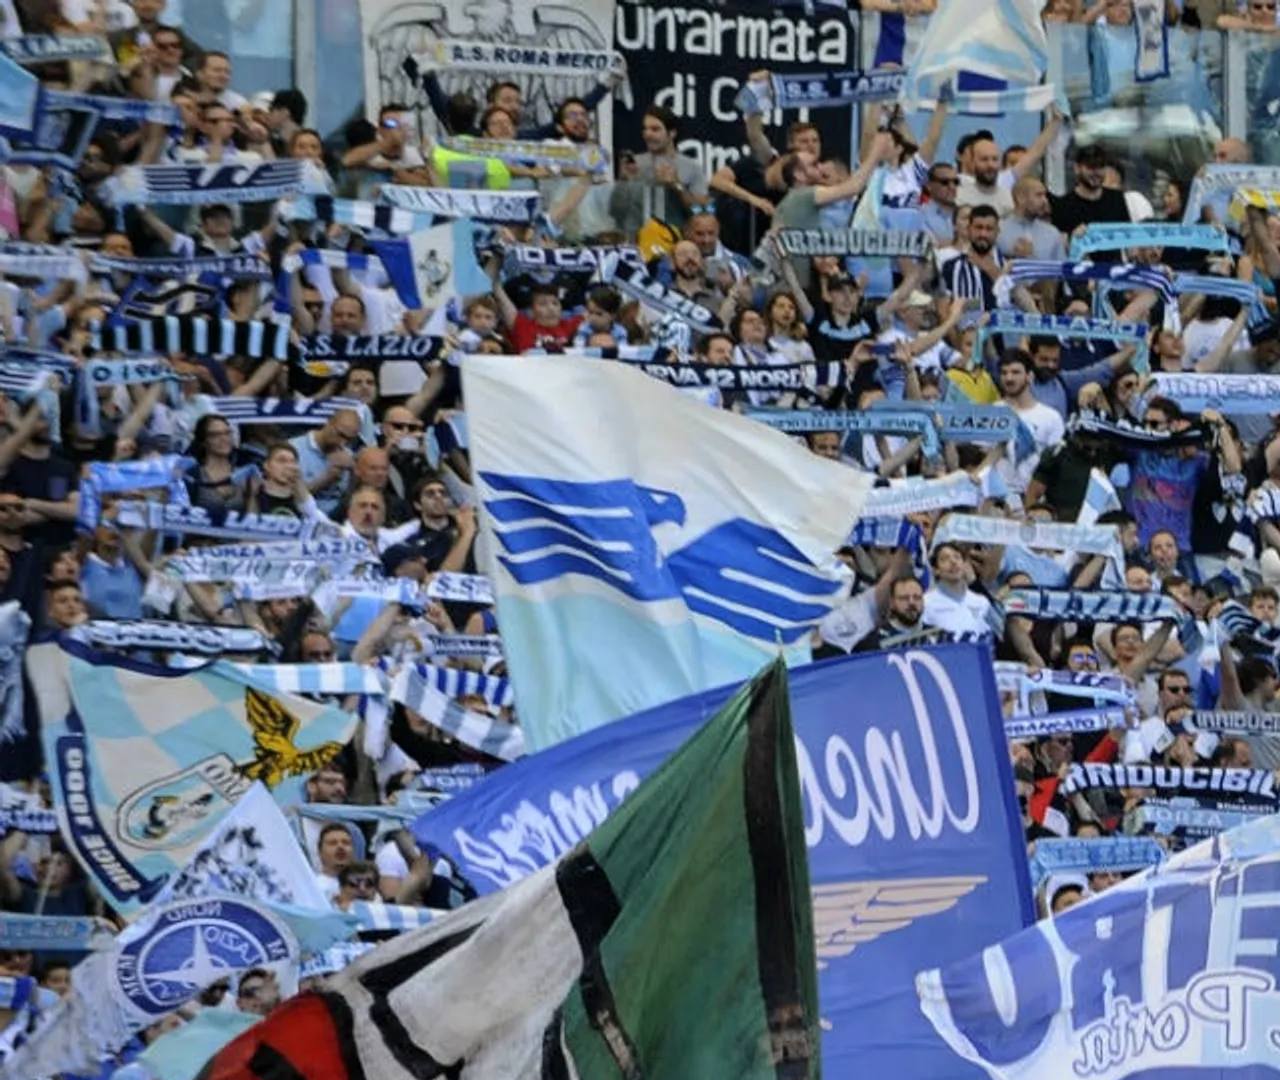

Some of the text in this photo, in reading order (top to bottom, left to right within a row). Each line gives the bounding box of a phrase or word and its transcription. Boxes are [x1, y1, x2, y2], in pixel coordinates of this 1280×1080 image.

[494, 48, 551, 66] ROMA
[843, 73, 905, 97] LAZIO
[347, 335, 433, 357] LAZIO
[951, 415, 1010, 430] LAZIO
[225, 509, 297, 535] LAZIO
[302, 540, 368, 556] LAZIO
